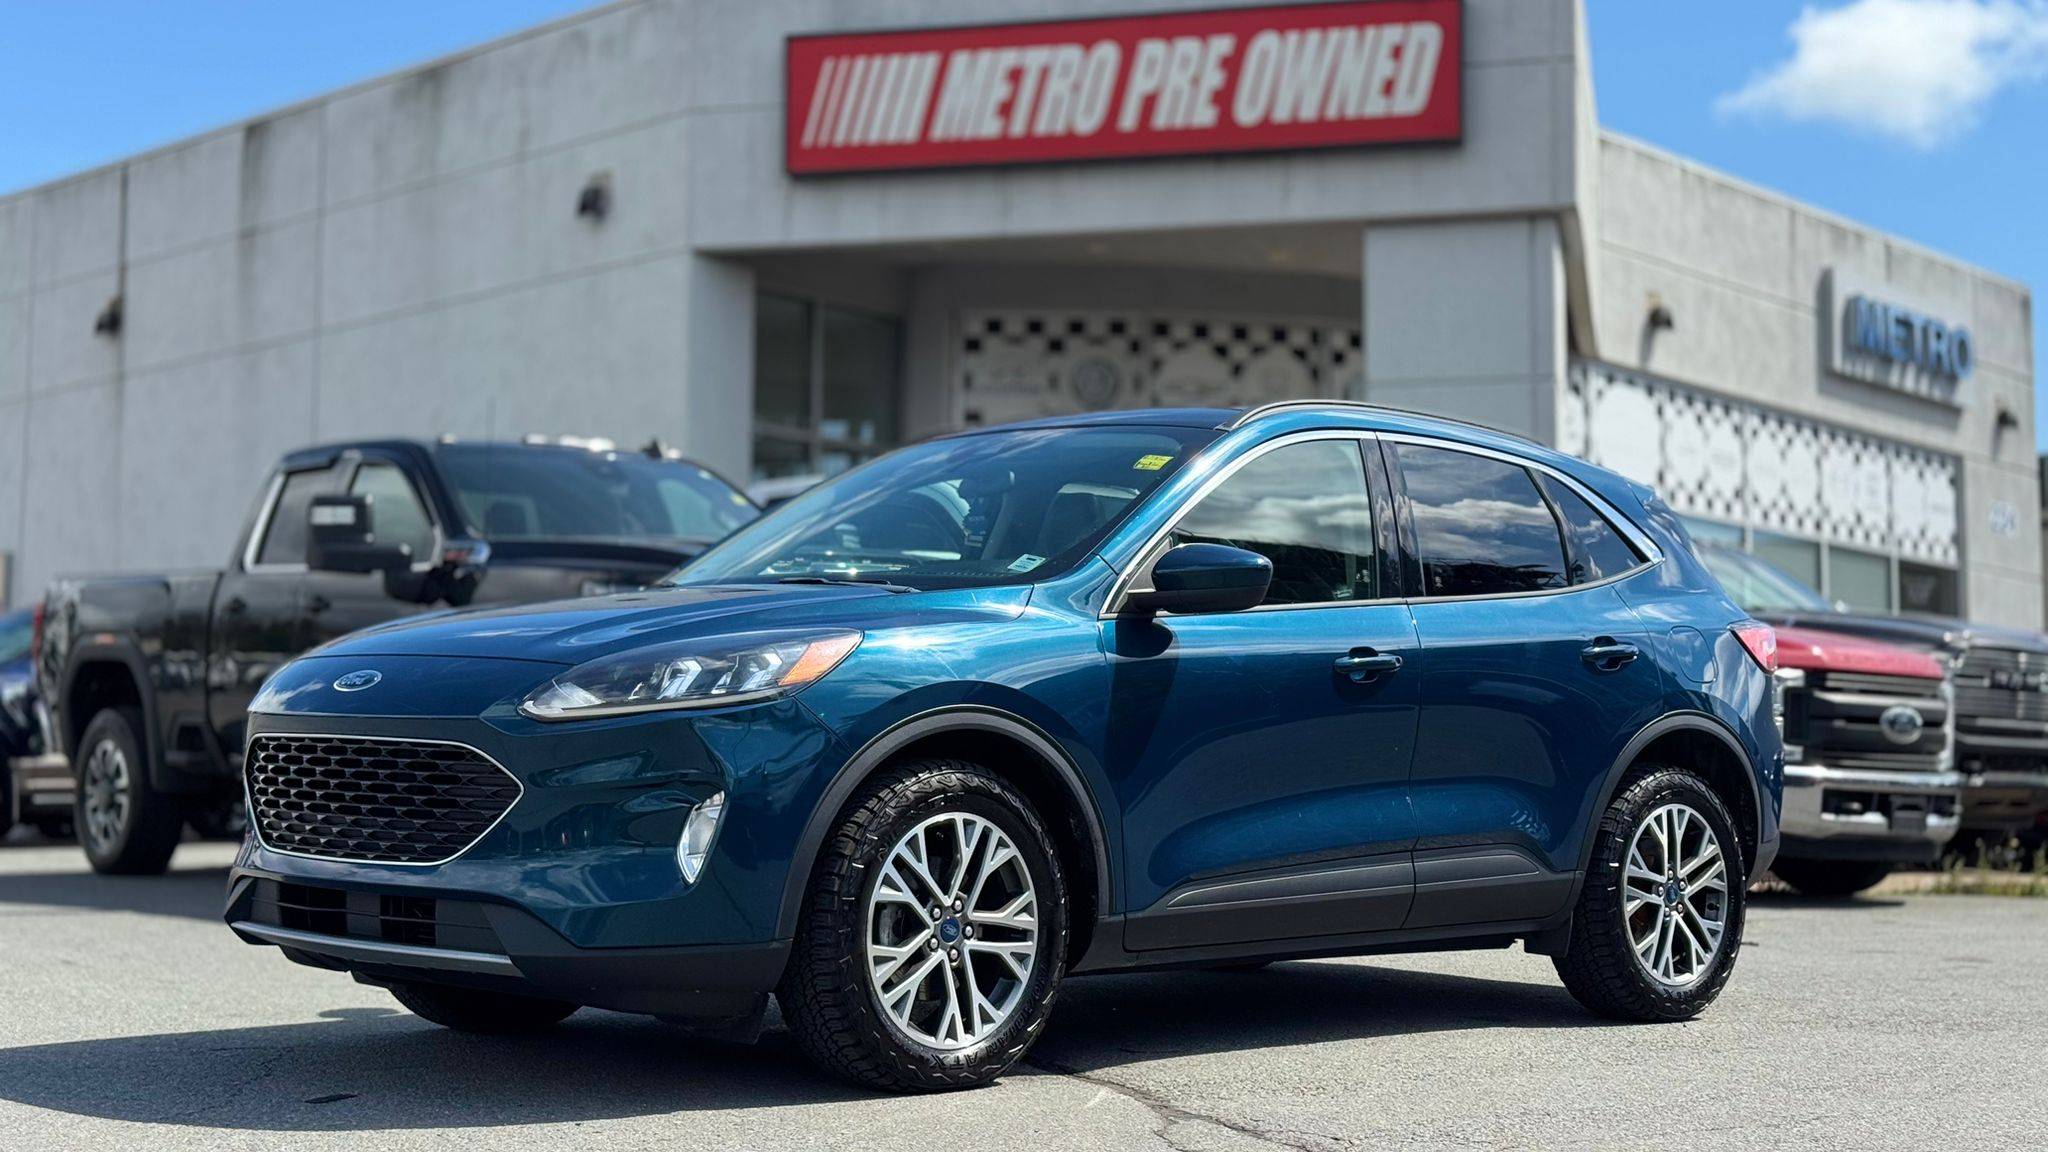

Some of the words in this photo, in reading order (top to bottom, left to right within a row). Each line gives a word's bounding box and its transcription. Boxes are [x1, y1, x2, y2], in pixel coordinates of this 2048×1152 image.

[928, 39, 1121, 142] METRO
[1116, 32, 1237, 132] PRE
[1231, 21, 1444, 128] OWNED
[1853, 295, 1973, 379] METRO
[929, 1051, 979, 1070] ATX
